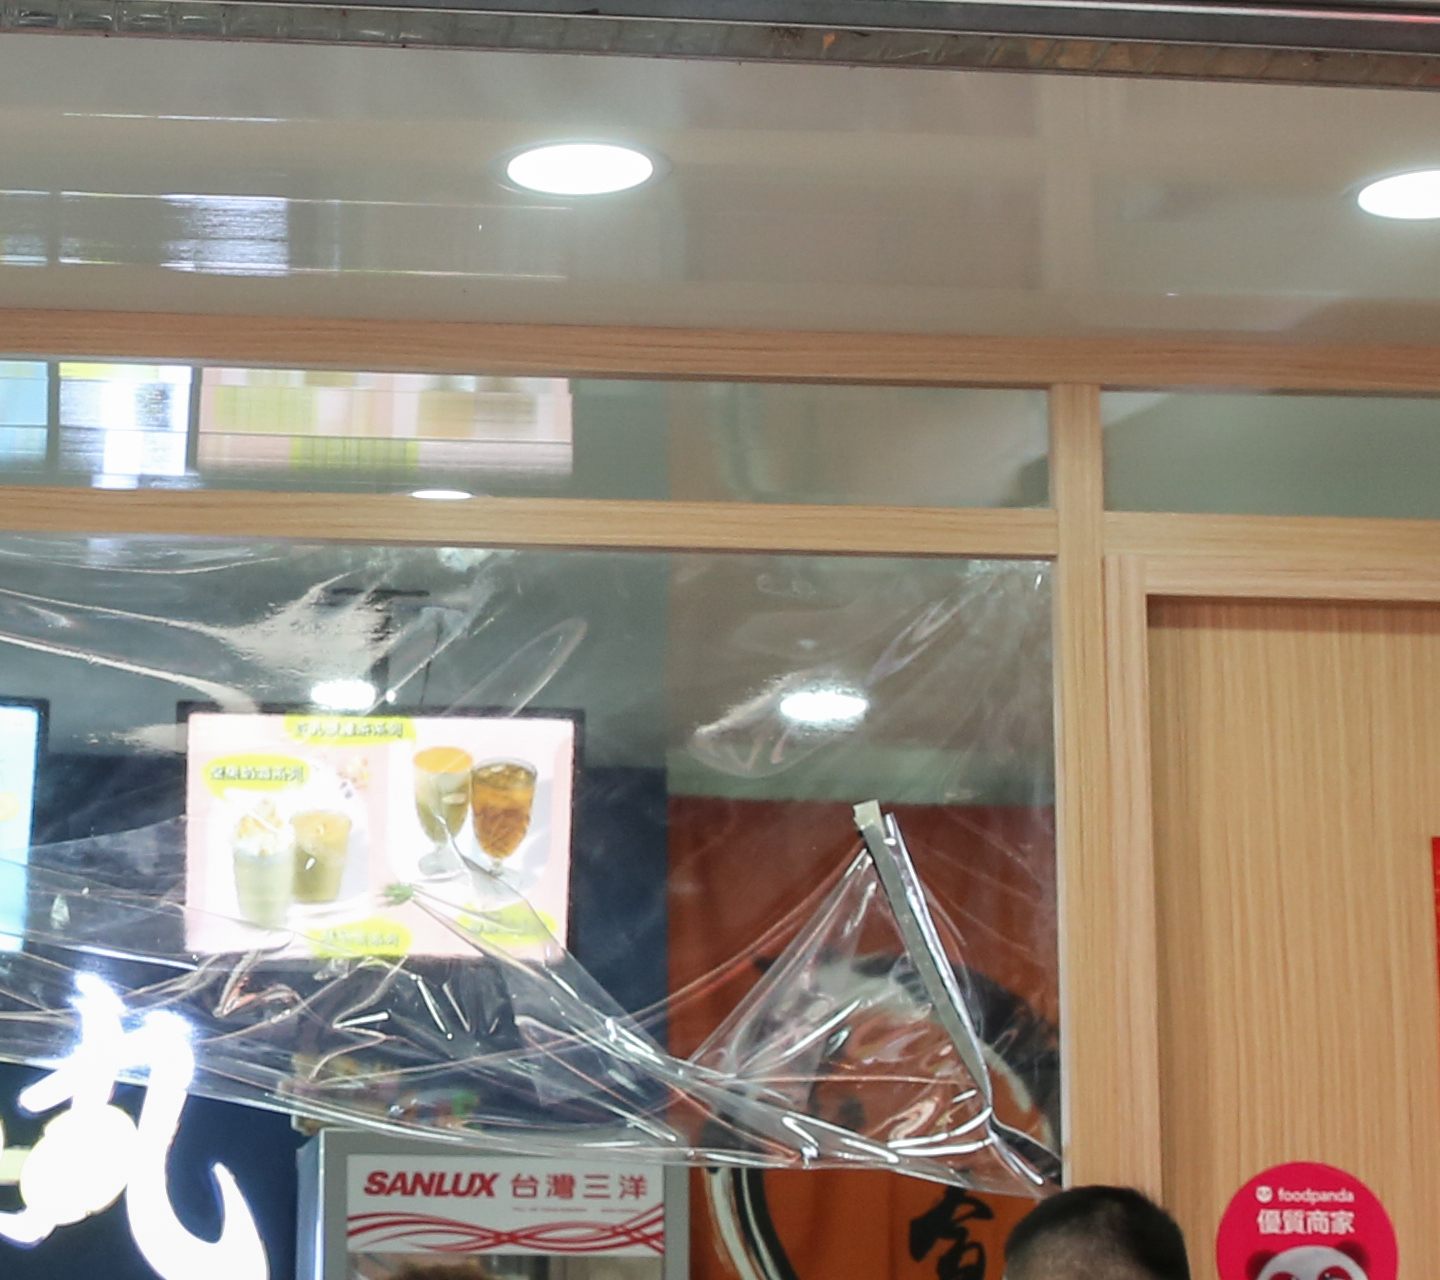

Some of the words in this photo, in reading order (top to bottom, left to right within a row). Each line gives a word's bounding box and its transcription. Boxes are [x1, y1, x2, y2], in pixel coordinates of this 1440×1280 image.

[364, 1171, 500, 1198] SANLUX
[510, 1173, 649, 1200] 台灣三洋
[1278, 1187, 1355, 1206] foodpanda
